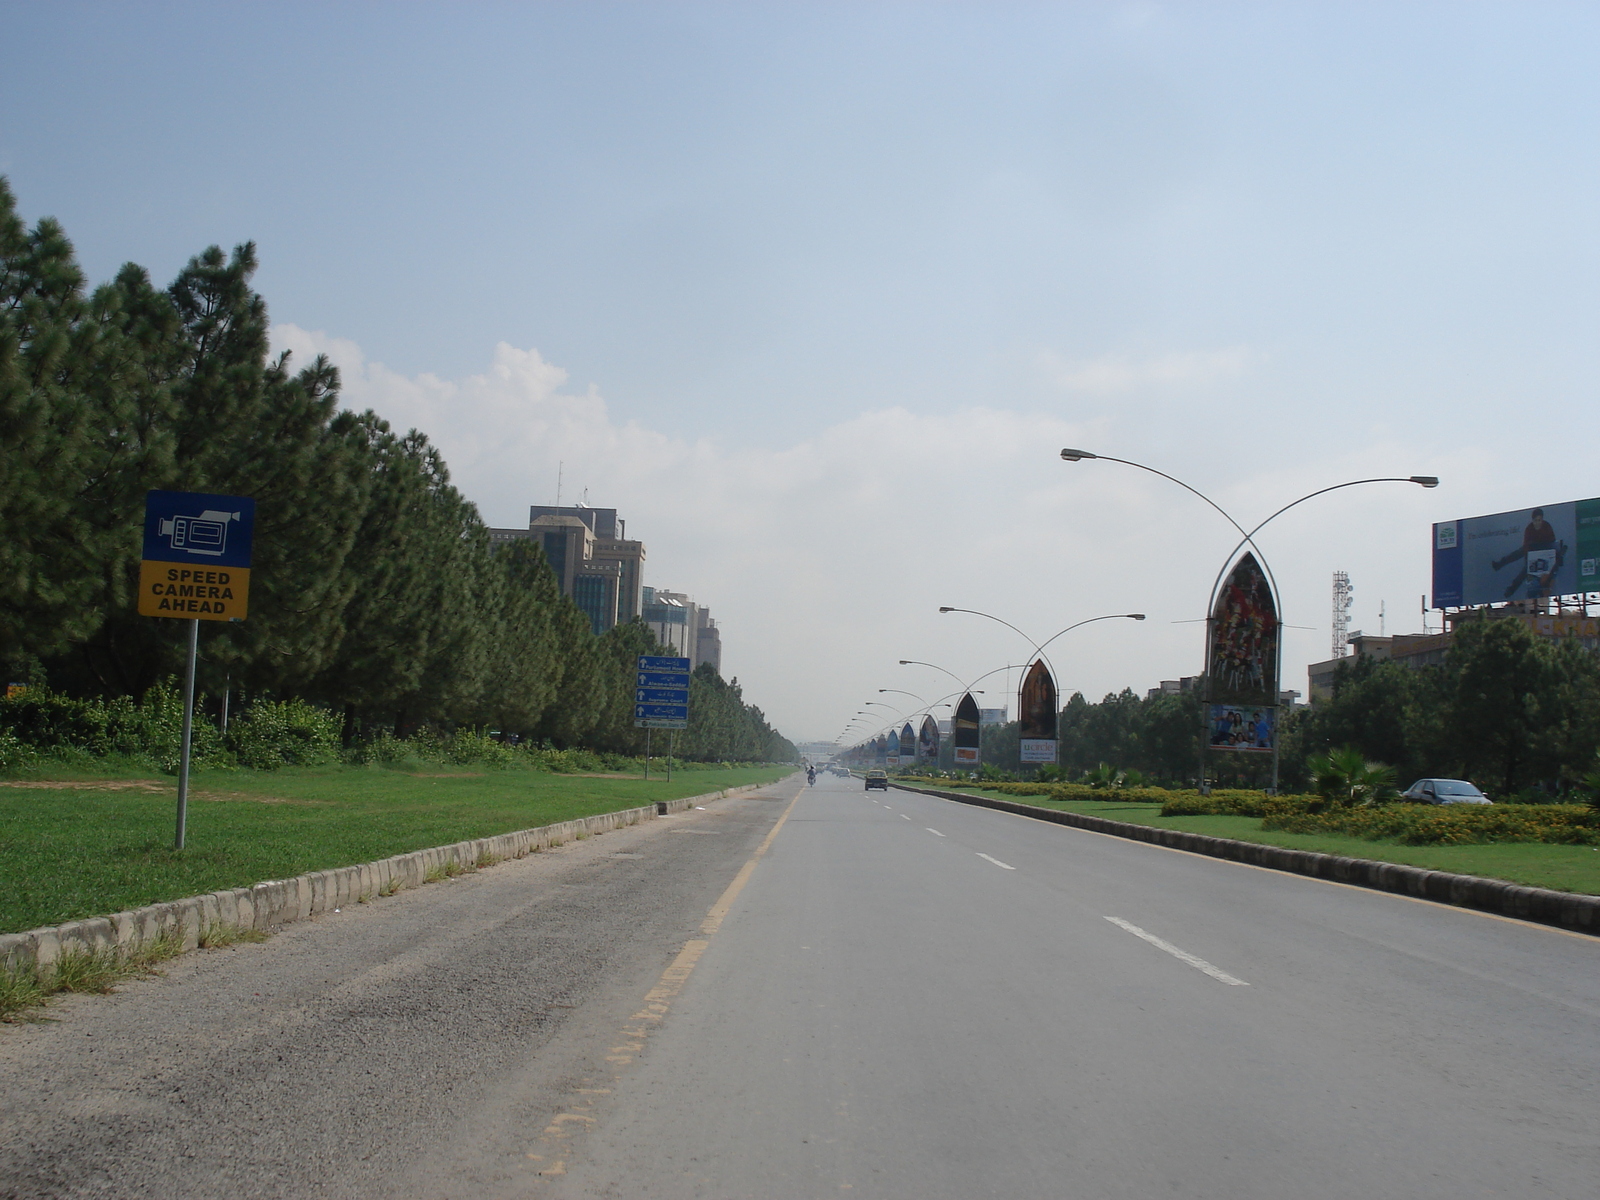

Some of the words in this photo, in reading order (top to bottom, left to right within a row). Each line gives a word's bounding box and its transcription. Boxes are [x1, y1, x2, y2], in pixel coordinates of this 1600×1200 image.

[168, 569, 230, 584] SPEED
[152, 583, 233, 599] CAMERA
[158, 598, 225, 613] AHEAD
